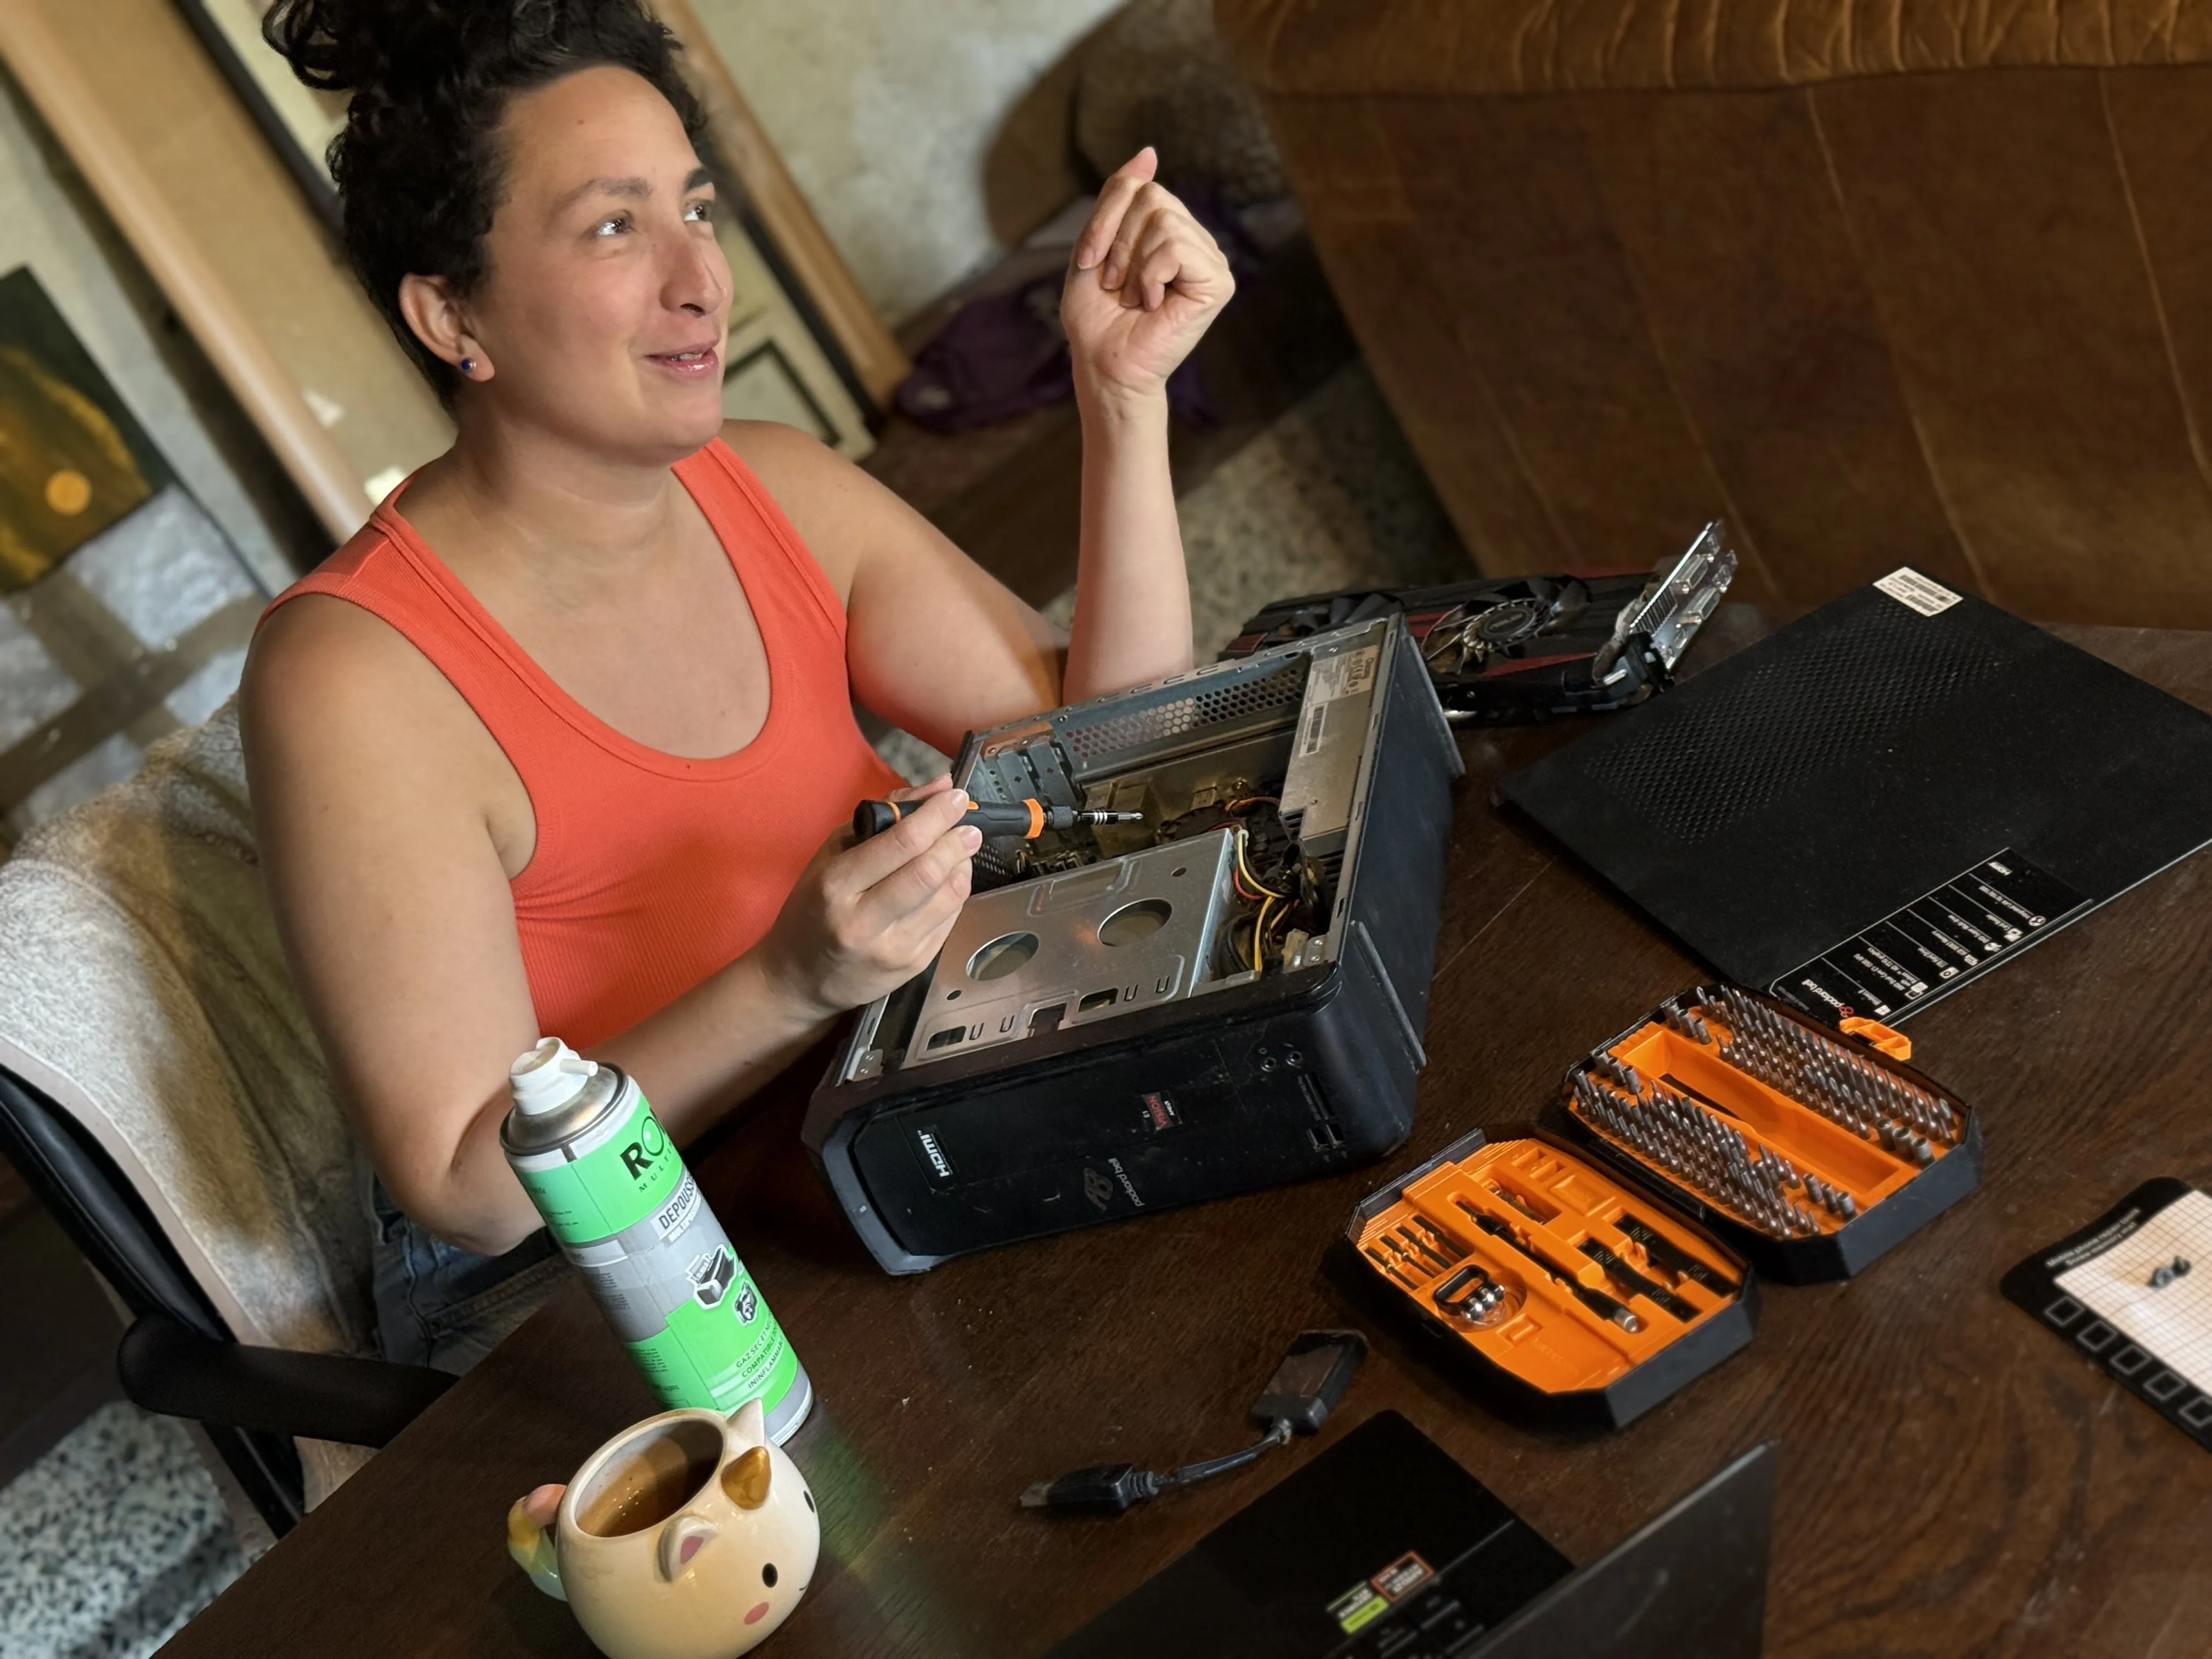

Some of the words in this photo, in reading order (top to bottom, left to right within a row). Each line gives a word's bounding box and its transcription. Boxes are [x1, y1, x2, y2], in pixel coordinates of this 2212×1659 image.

[1801, 978, 1818, 990] bell
[1812, 987, 1845, 1008] packard
[1147, 1094, 1168, 1126] VISION
[1107, 1157, 1124, 1173] bell
[1116, 1173, 1145, 1207] packard
[2074, 1237, 2098, 1254] phone
[2098, 1222, 2120, 1240] repair
[2119, 1207, 2140, 1225] tools
[2090, 1232, 2122, 1254] memory
[2121, 1221, 2136, 1234] mat
[736, 1353, 752, 1368] GAZ
[751, 1340, 762, 1355] SEC
[760, 1330, 767, 1342] ET
